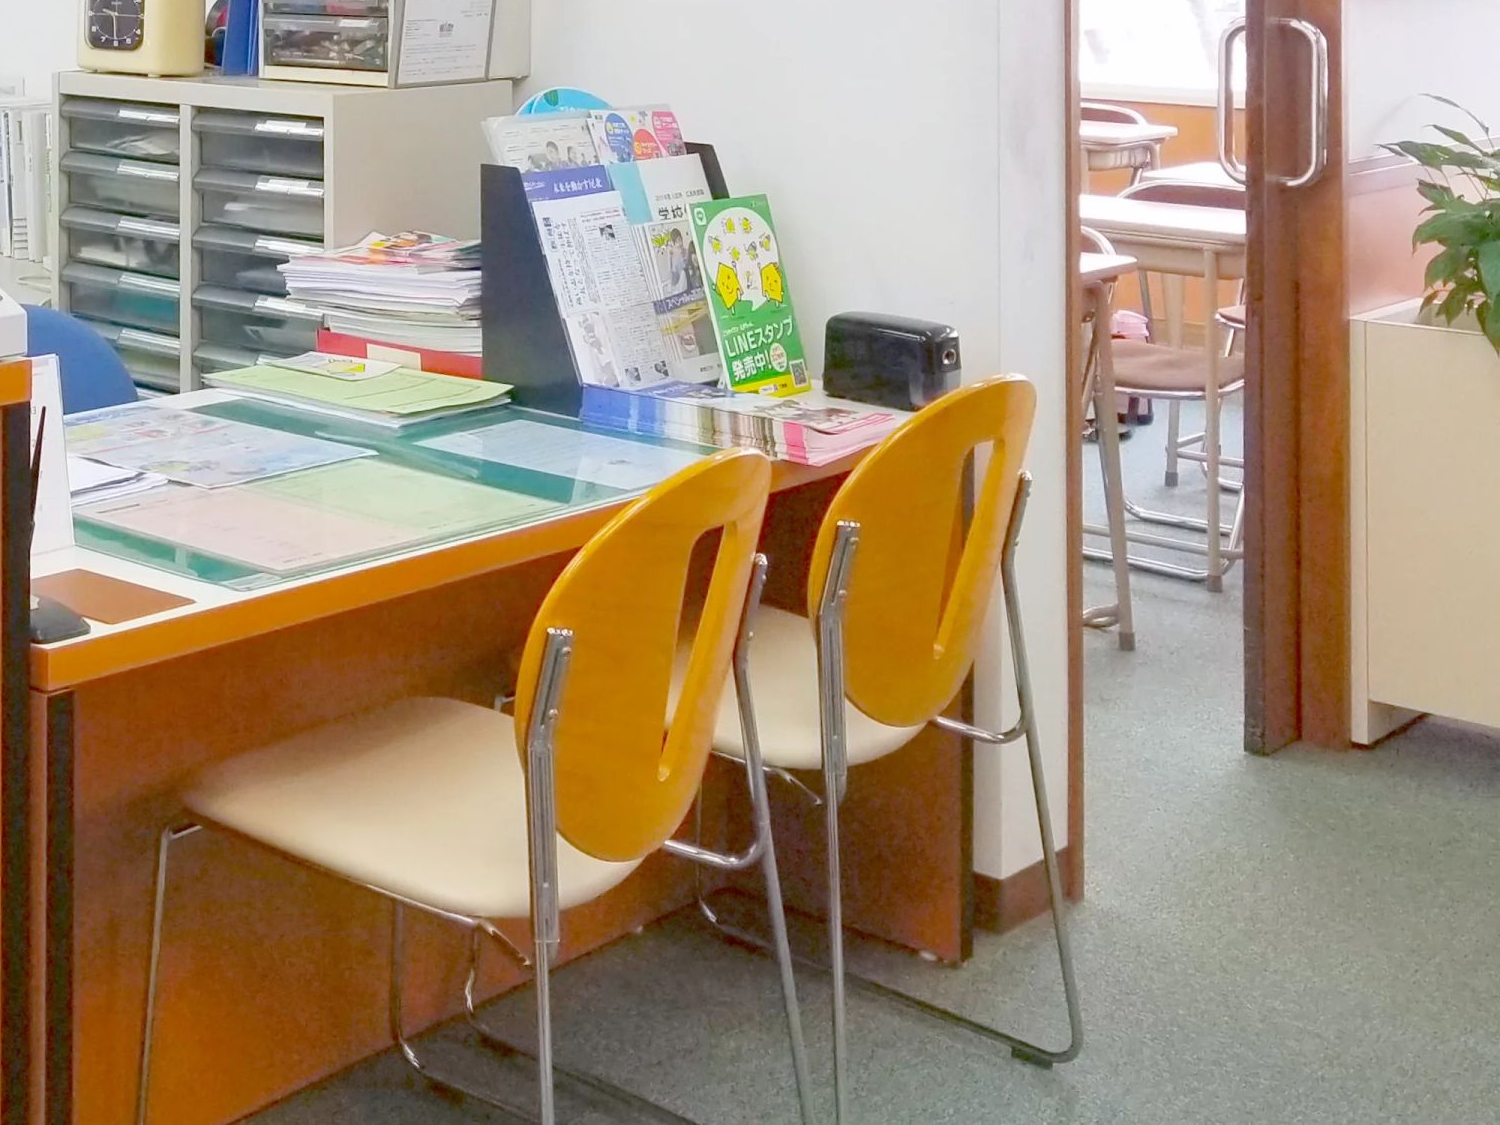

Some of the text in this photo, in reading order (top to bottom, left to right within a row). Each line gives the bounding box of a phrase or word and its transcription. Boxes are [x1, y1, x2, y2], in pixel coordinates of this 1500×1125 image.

[724, 315, 794, 358] LINEスタンプ
[731, 349, 773, 382] 発売中!
